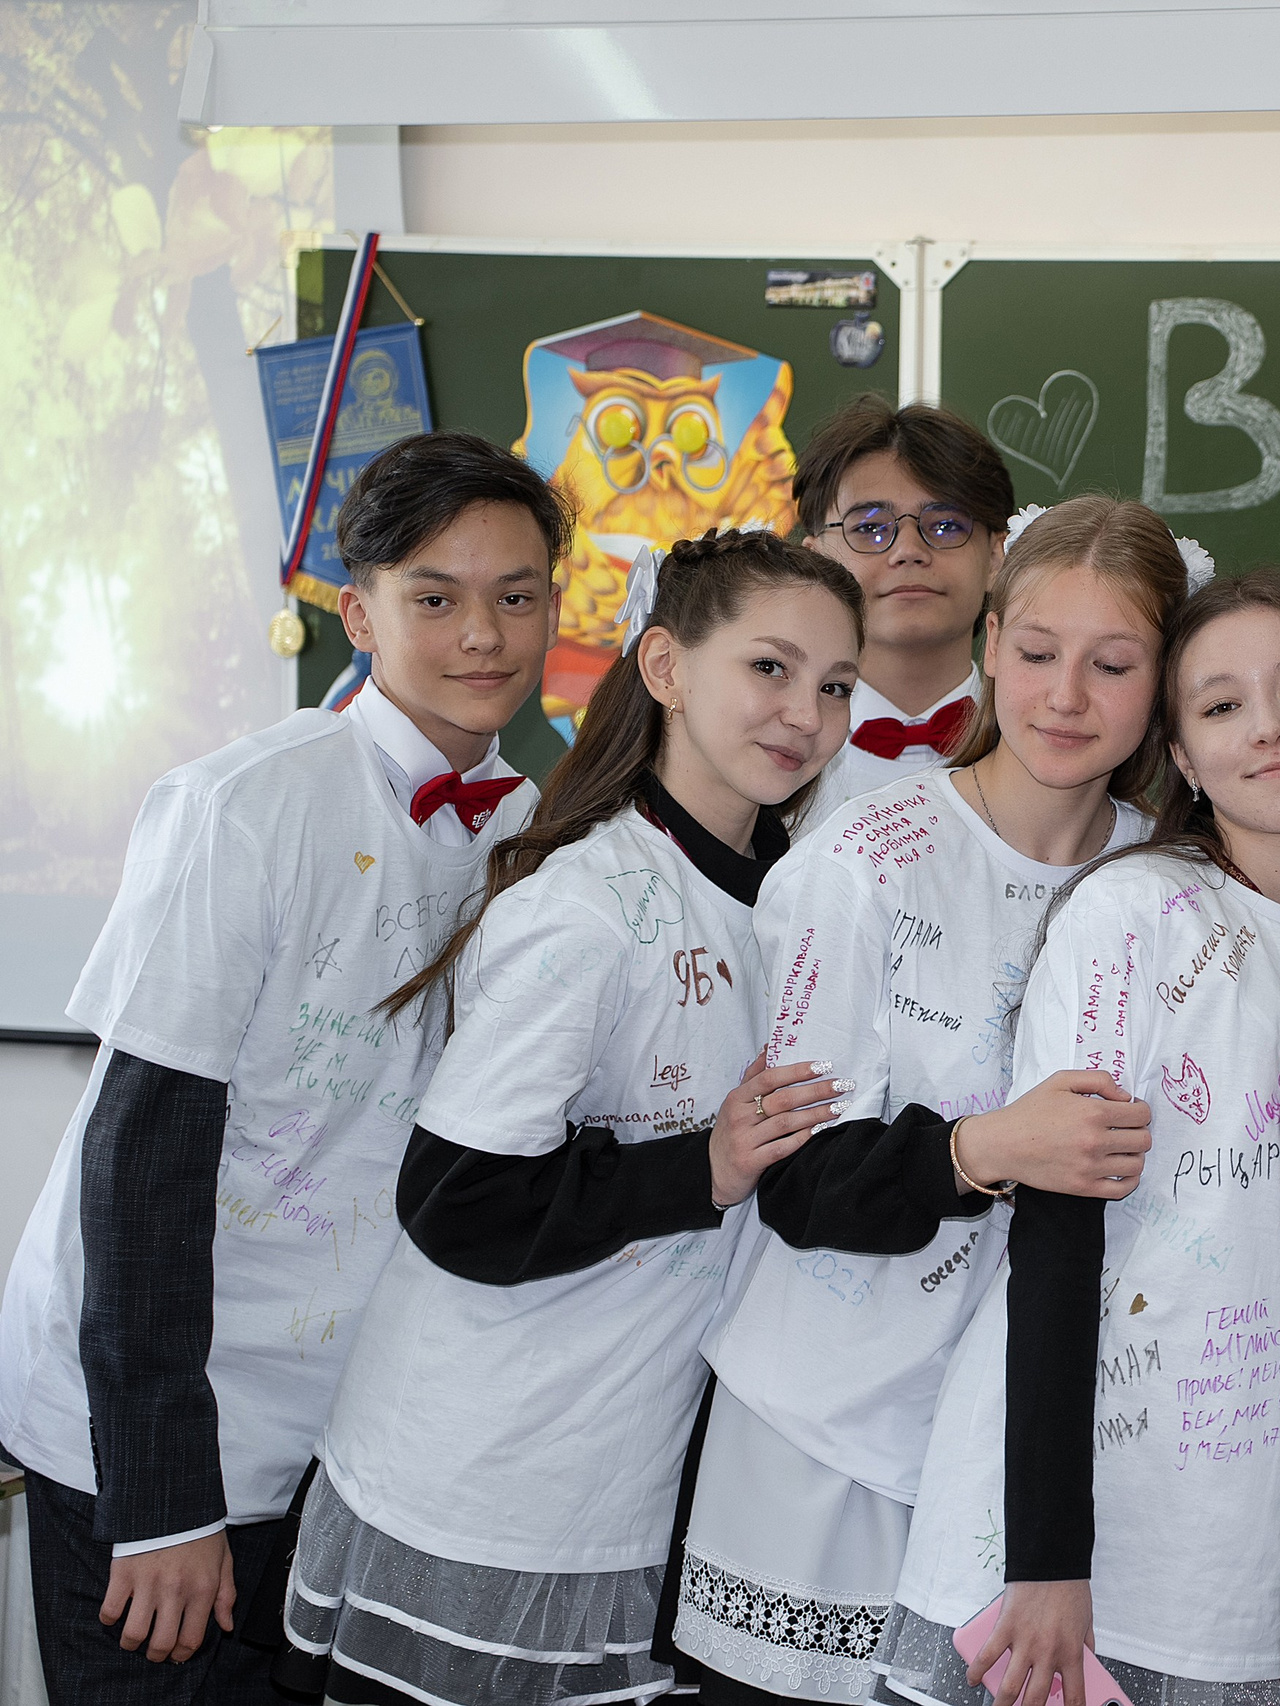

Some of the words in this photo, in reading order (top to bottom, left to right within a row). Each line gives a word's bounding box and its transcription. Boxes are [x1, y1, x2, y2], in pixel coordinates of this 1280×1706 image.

[865, 816, 913, 843] САМАЯ
[868, 826, 930, 869] ЛЮБИМАЯ
[893, 848, 922, 870] МОЯ
[893, 991, 963, 1033] ЕРЕЖНОЙ
[1083, 973, 1104, 1032] САМАЯ
[920, 1230, 980, 1293] соседка
[1205, 1298, 1270, 1334] ГЕНИЙ
[1197, 1439, 1254, 1463] МЕНЯ
